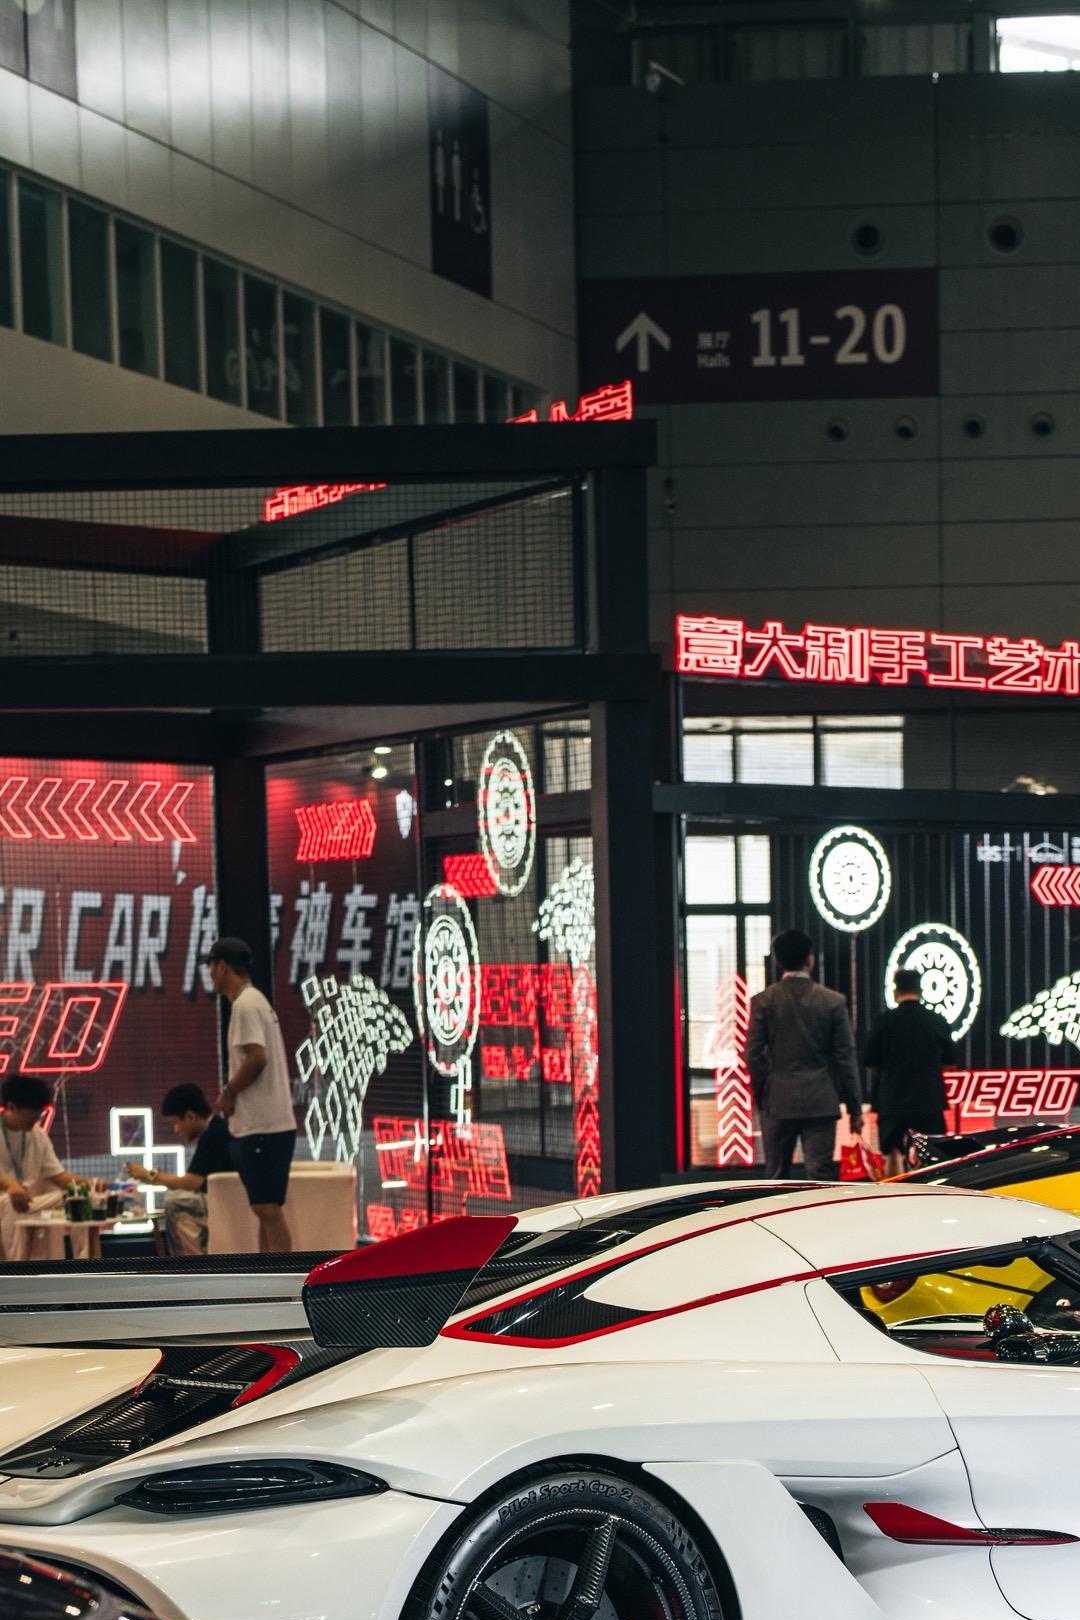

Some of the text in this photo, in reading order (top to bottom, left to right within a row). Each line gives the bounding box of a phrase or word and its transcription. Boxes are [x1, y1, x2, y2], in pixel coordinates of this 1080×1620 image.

[698, 353, 730, 368] Halls
[752, 304, 906, 366] 11-20
[63, 889, 171, 989] CAR
[498, 1479, 634, 1524] Pilot Sport Cup 2
